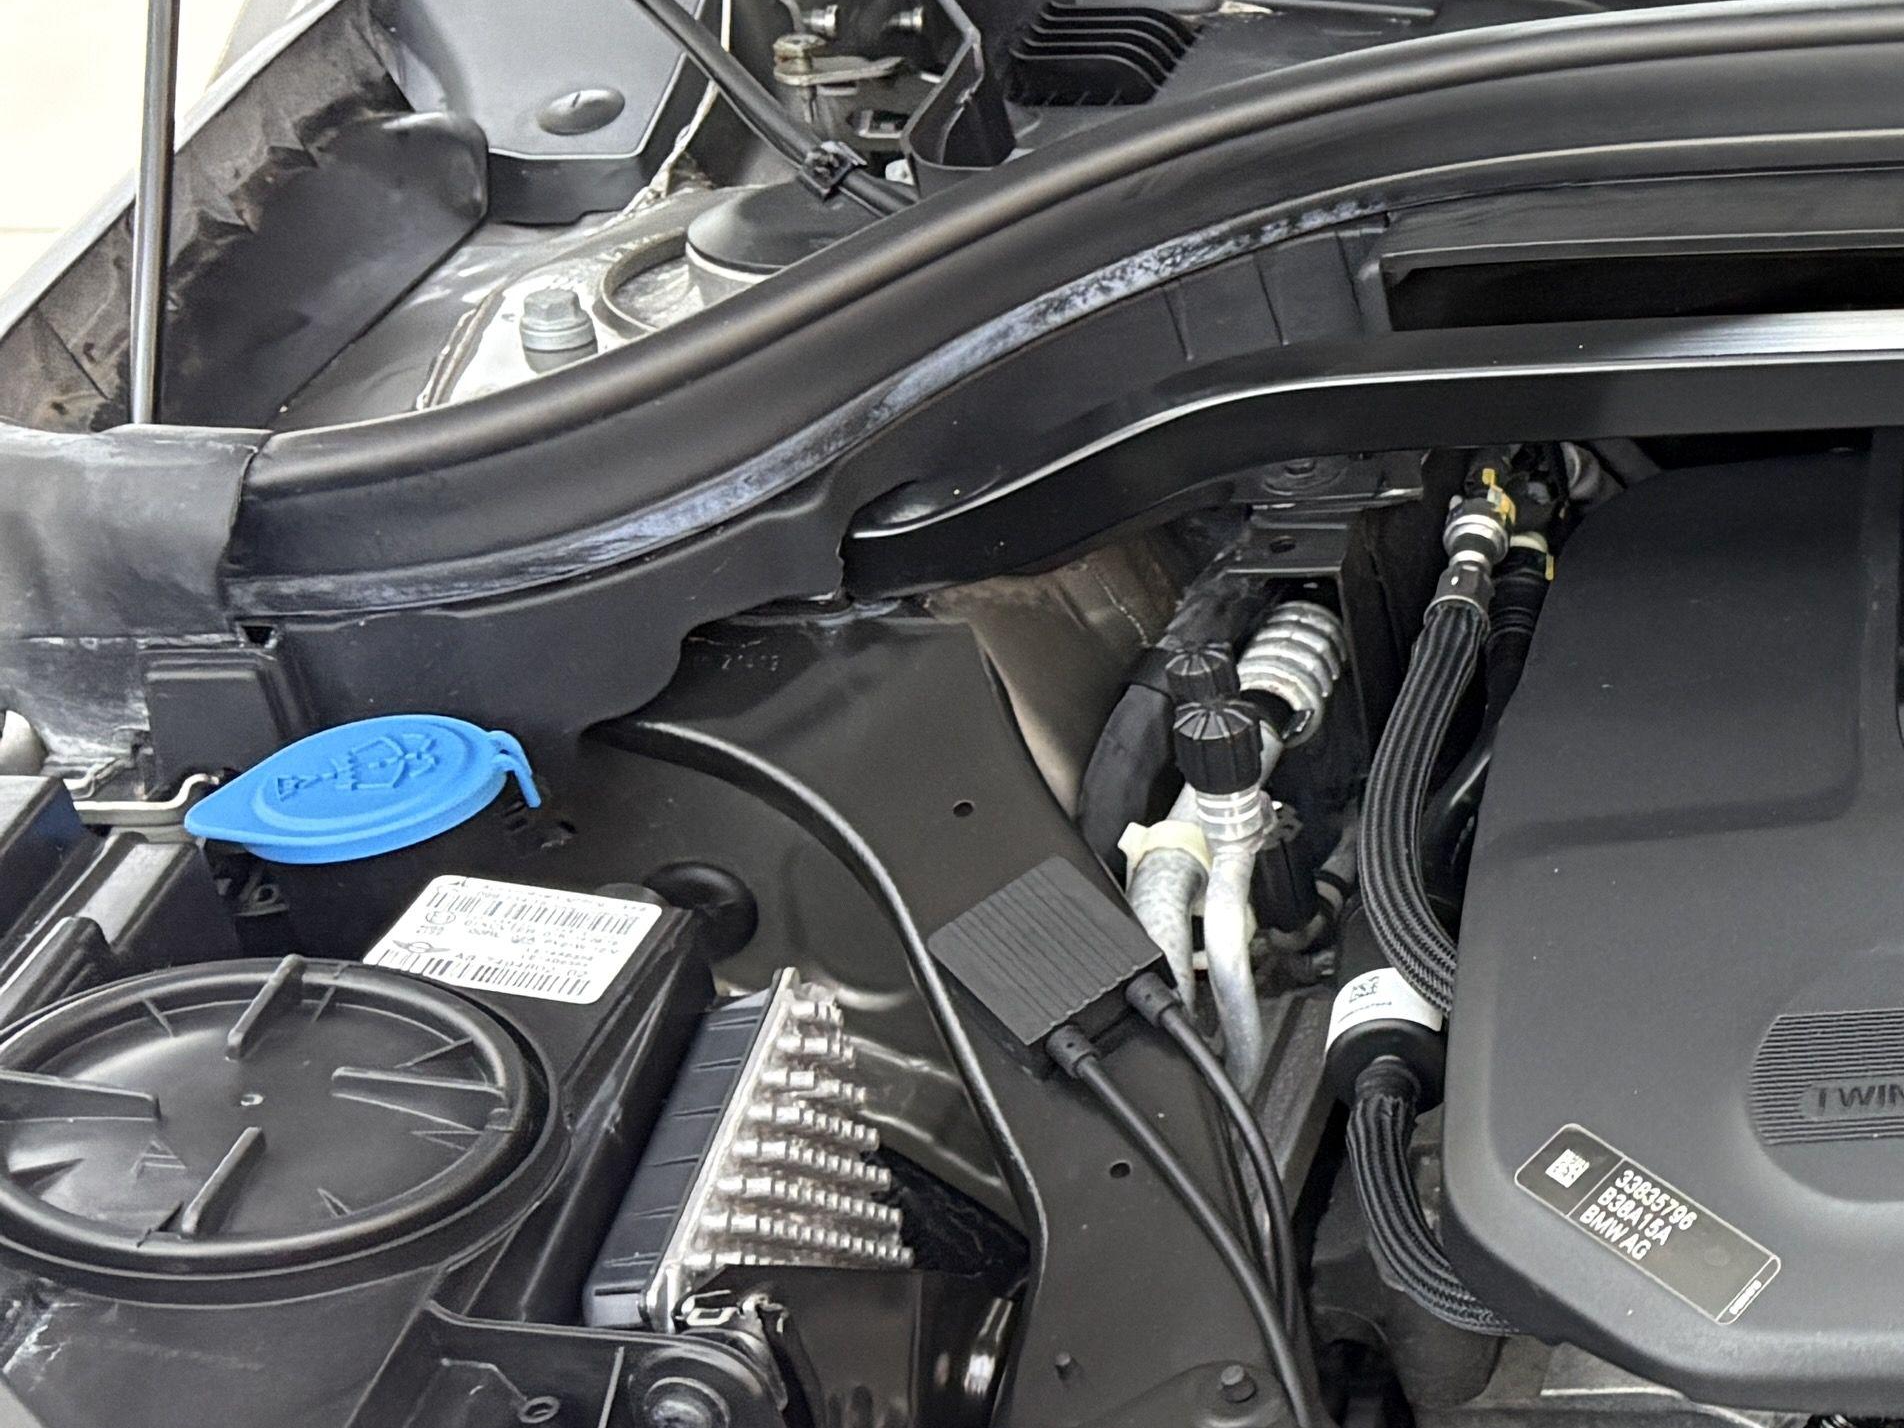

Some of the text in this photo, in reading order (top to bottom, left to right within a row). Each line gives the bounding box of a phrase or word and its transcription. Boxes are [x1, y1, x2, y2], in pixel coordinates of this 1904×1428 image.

[1578, 1203, 1652, 1261] BMW AG
[1597, 1186, 1673, 1246] B38A15A
